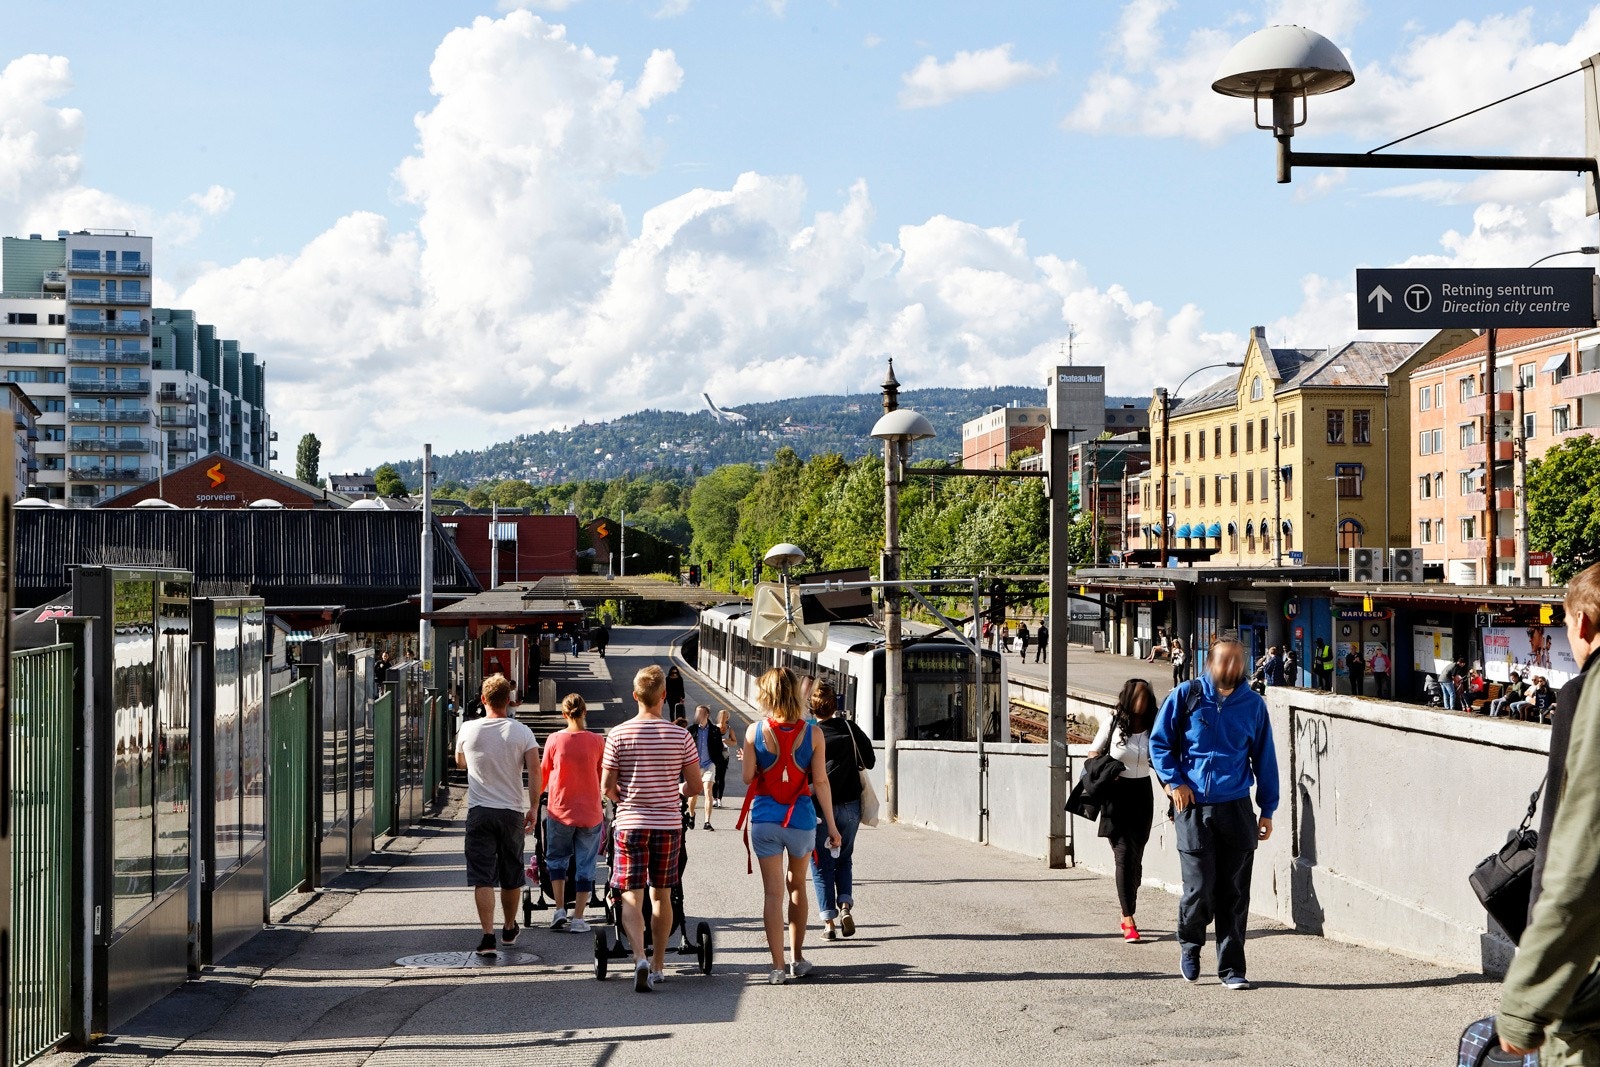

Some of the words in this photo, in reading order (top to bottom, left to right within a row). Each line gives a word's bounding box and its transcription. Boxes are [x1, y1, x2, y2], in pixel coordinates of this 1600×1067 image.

[1442, 283, 1493, 299] Retning
[1497, 284, 1554, 296] sentrum
[1442, 300, 1500, 313] Direction
[1503, 300, 1527, 315] city
[1529, 300, 1570, 312] centre
[1059, 374, 1086, 383] Chateau
[1087, 374, 1102, 383] Neuf
[196, 493, 236, 502] sporveien
[1288, 603, 1297, 615] N
[1480, 615, 1486, 624] 2
[1343, 626, 1350, 634] N
[1372, 626, 1379, 634] N
[1539, 698, 1545, 708] 3
